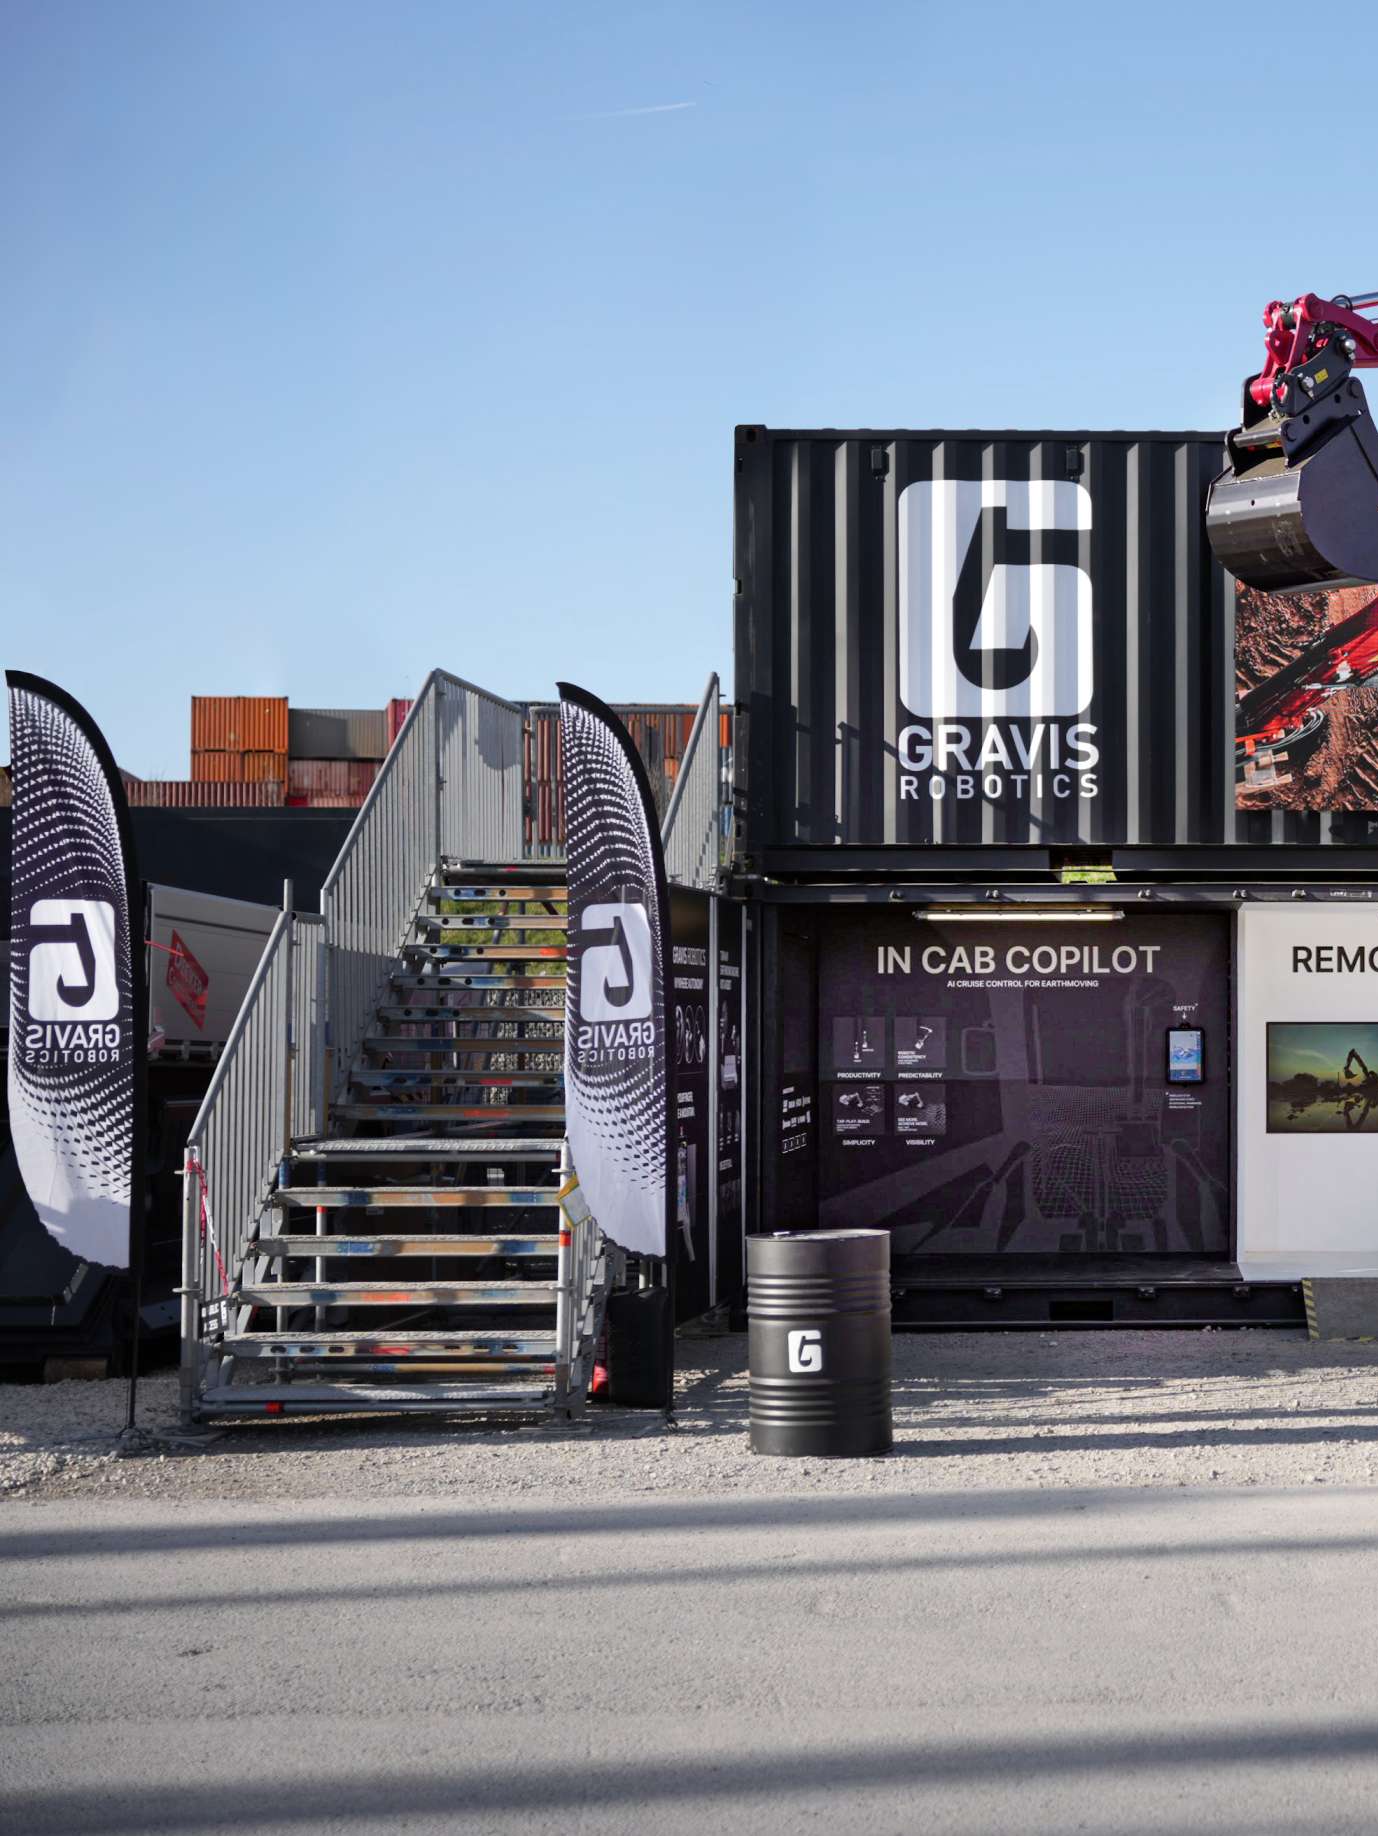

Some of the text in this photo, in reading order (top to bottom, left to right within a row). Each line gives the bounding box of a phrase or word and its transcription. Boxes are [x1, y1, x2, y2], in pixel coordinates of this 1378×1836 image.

[898, 723, 1100, 772] GRAVIS
[900, 773, 1099, 800] ROBOTICS
[877, 945, 1161, 974] IN CAB COPILOT
[947, 979, 1099, 988] AI CRUISE CONTROL FOR EARTHMOVING
